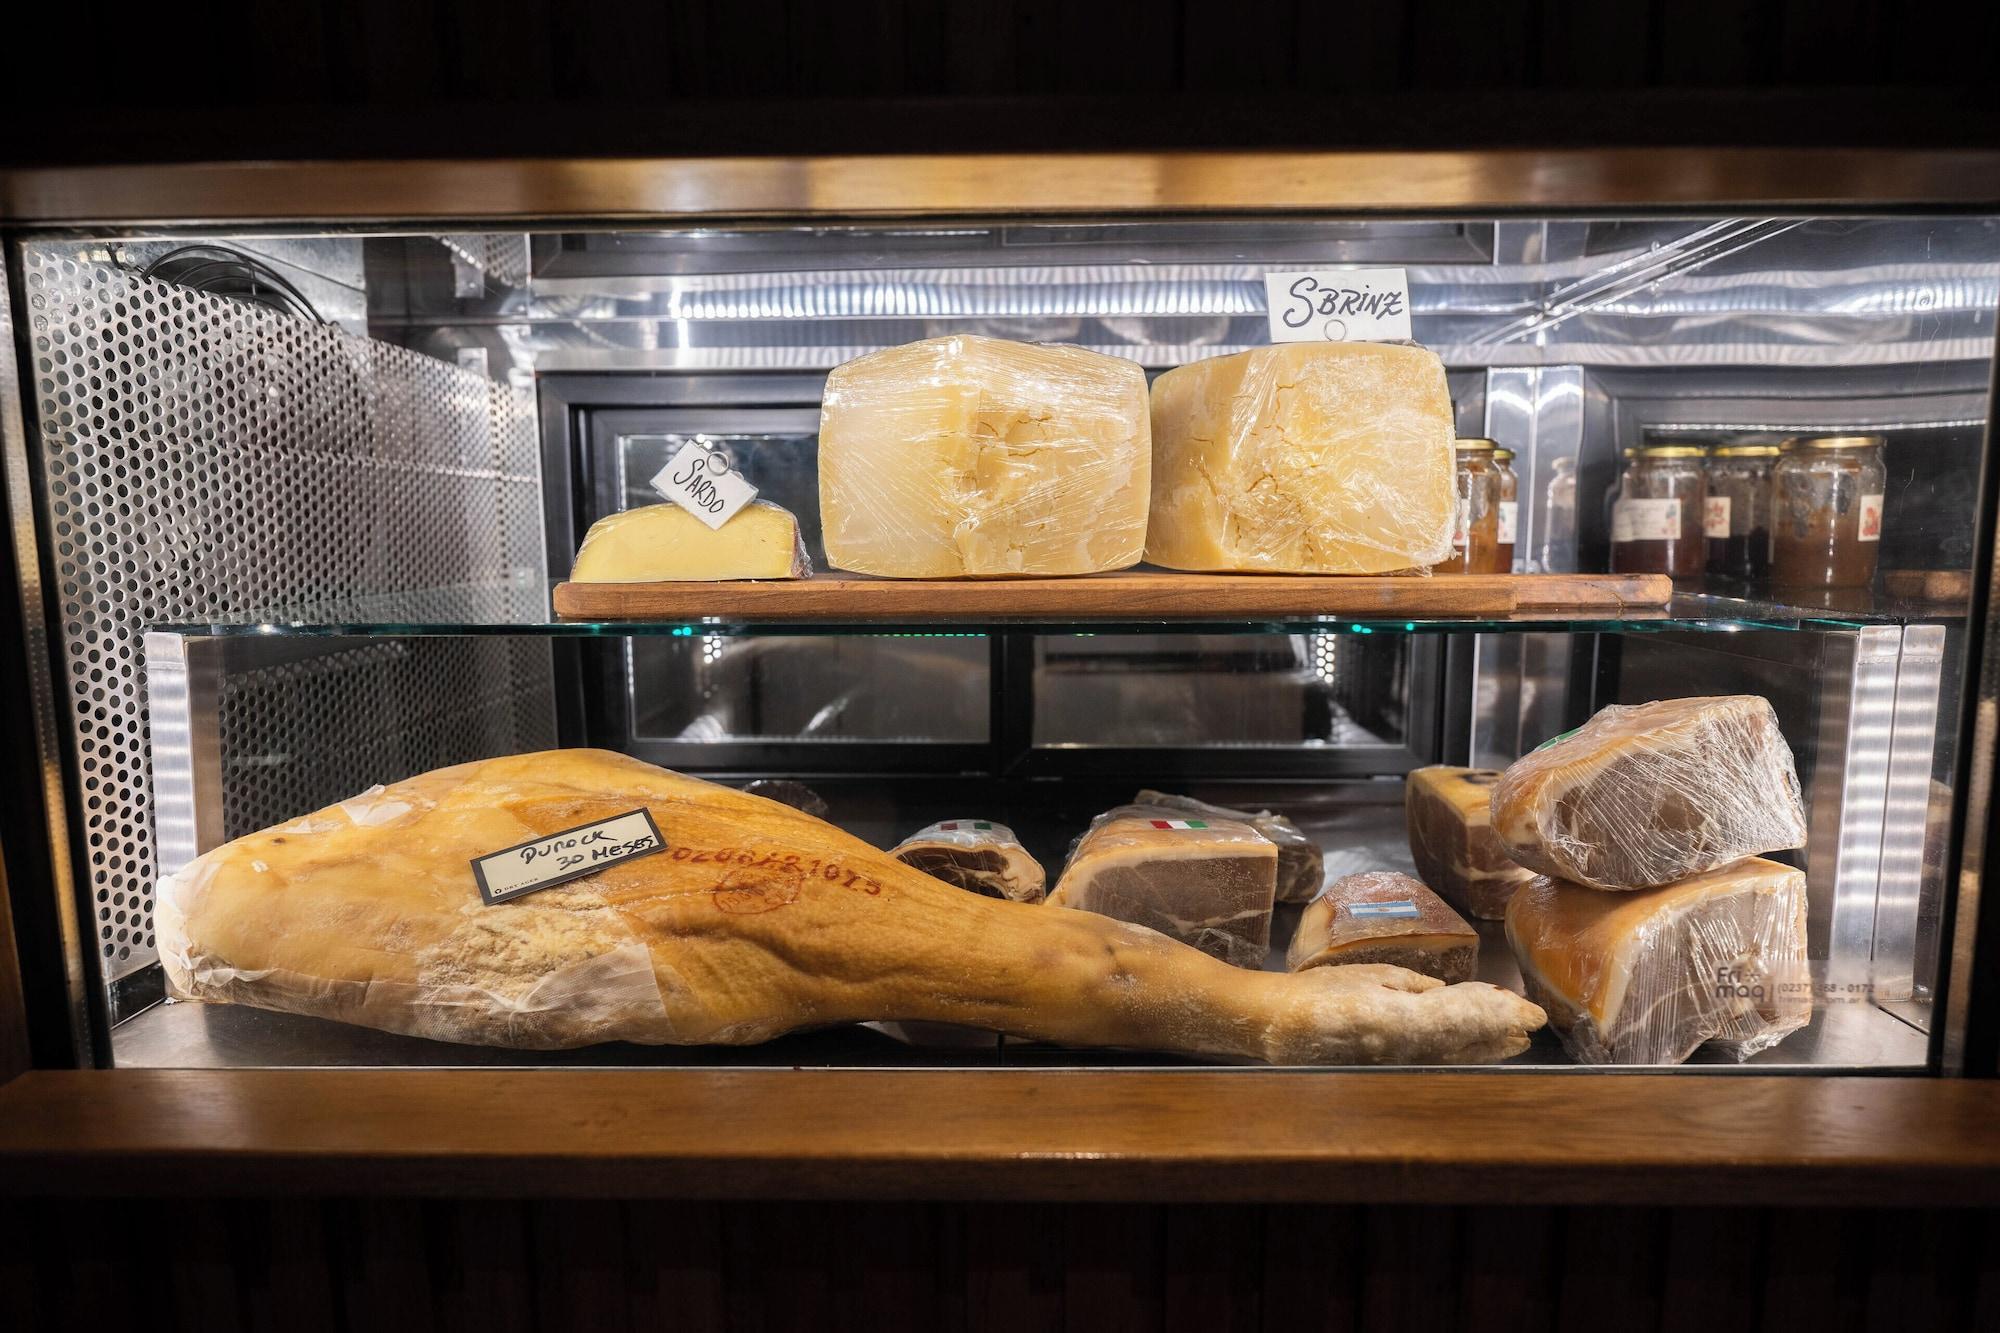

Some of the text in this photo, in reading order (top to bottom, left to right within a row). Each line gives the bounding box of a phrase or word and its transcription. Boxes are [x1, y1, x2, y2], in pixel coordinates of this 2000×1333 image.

[673, 458, 725, 514] SARDO
[556, 835, 655, 871] 30 MESES
[1716, 966, 1742, 984] Fri
[1715, 984, 1765, 1003] maq
